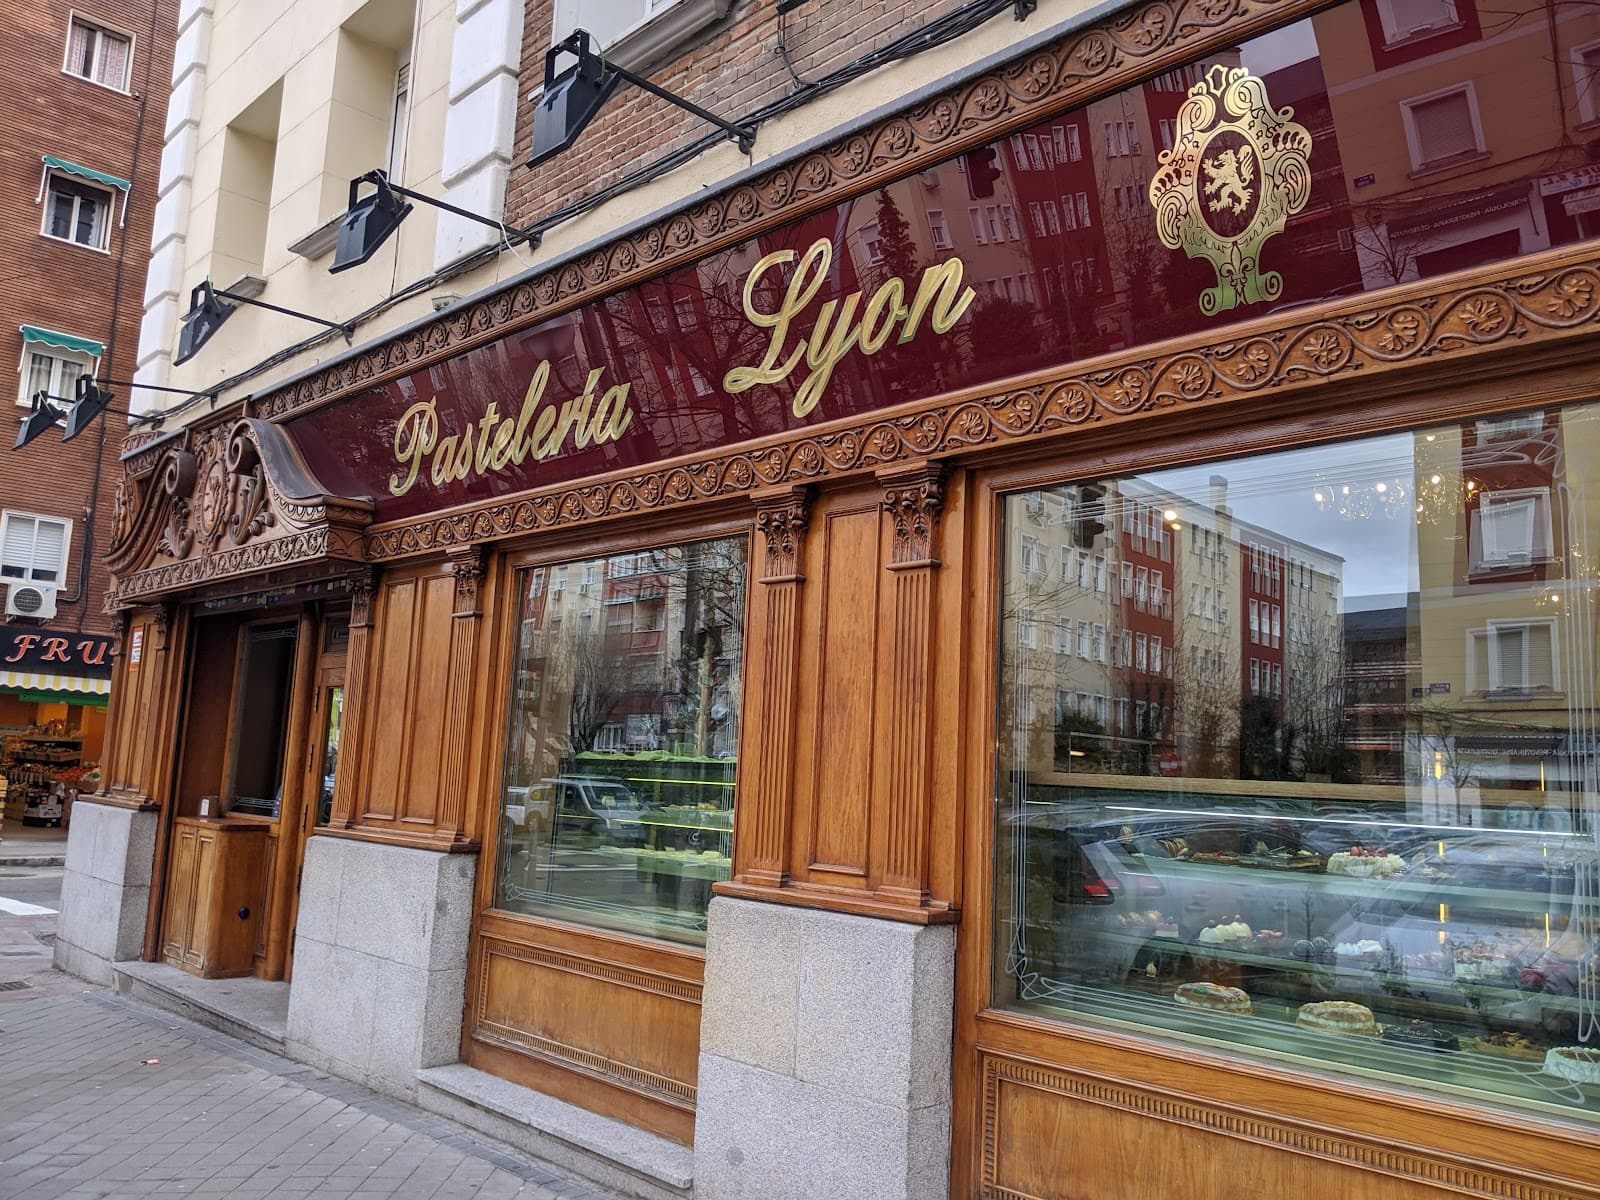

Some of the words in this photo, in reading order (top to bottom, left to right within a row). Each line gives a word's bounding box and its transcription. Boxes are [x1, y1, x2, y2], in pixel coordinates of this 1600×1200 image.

[389, 359, 634, 497] Pastelería
[723, 237, 977, 418] Lyon
[4, 633, 114, 667] FRU
